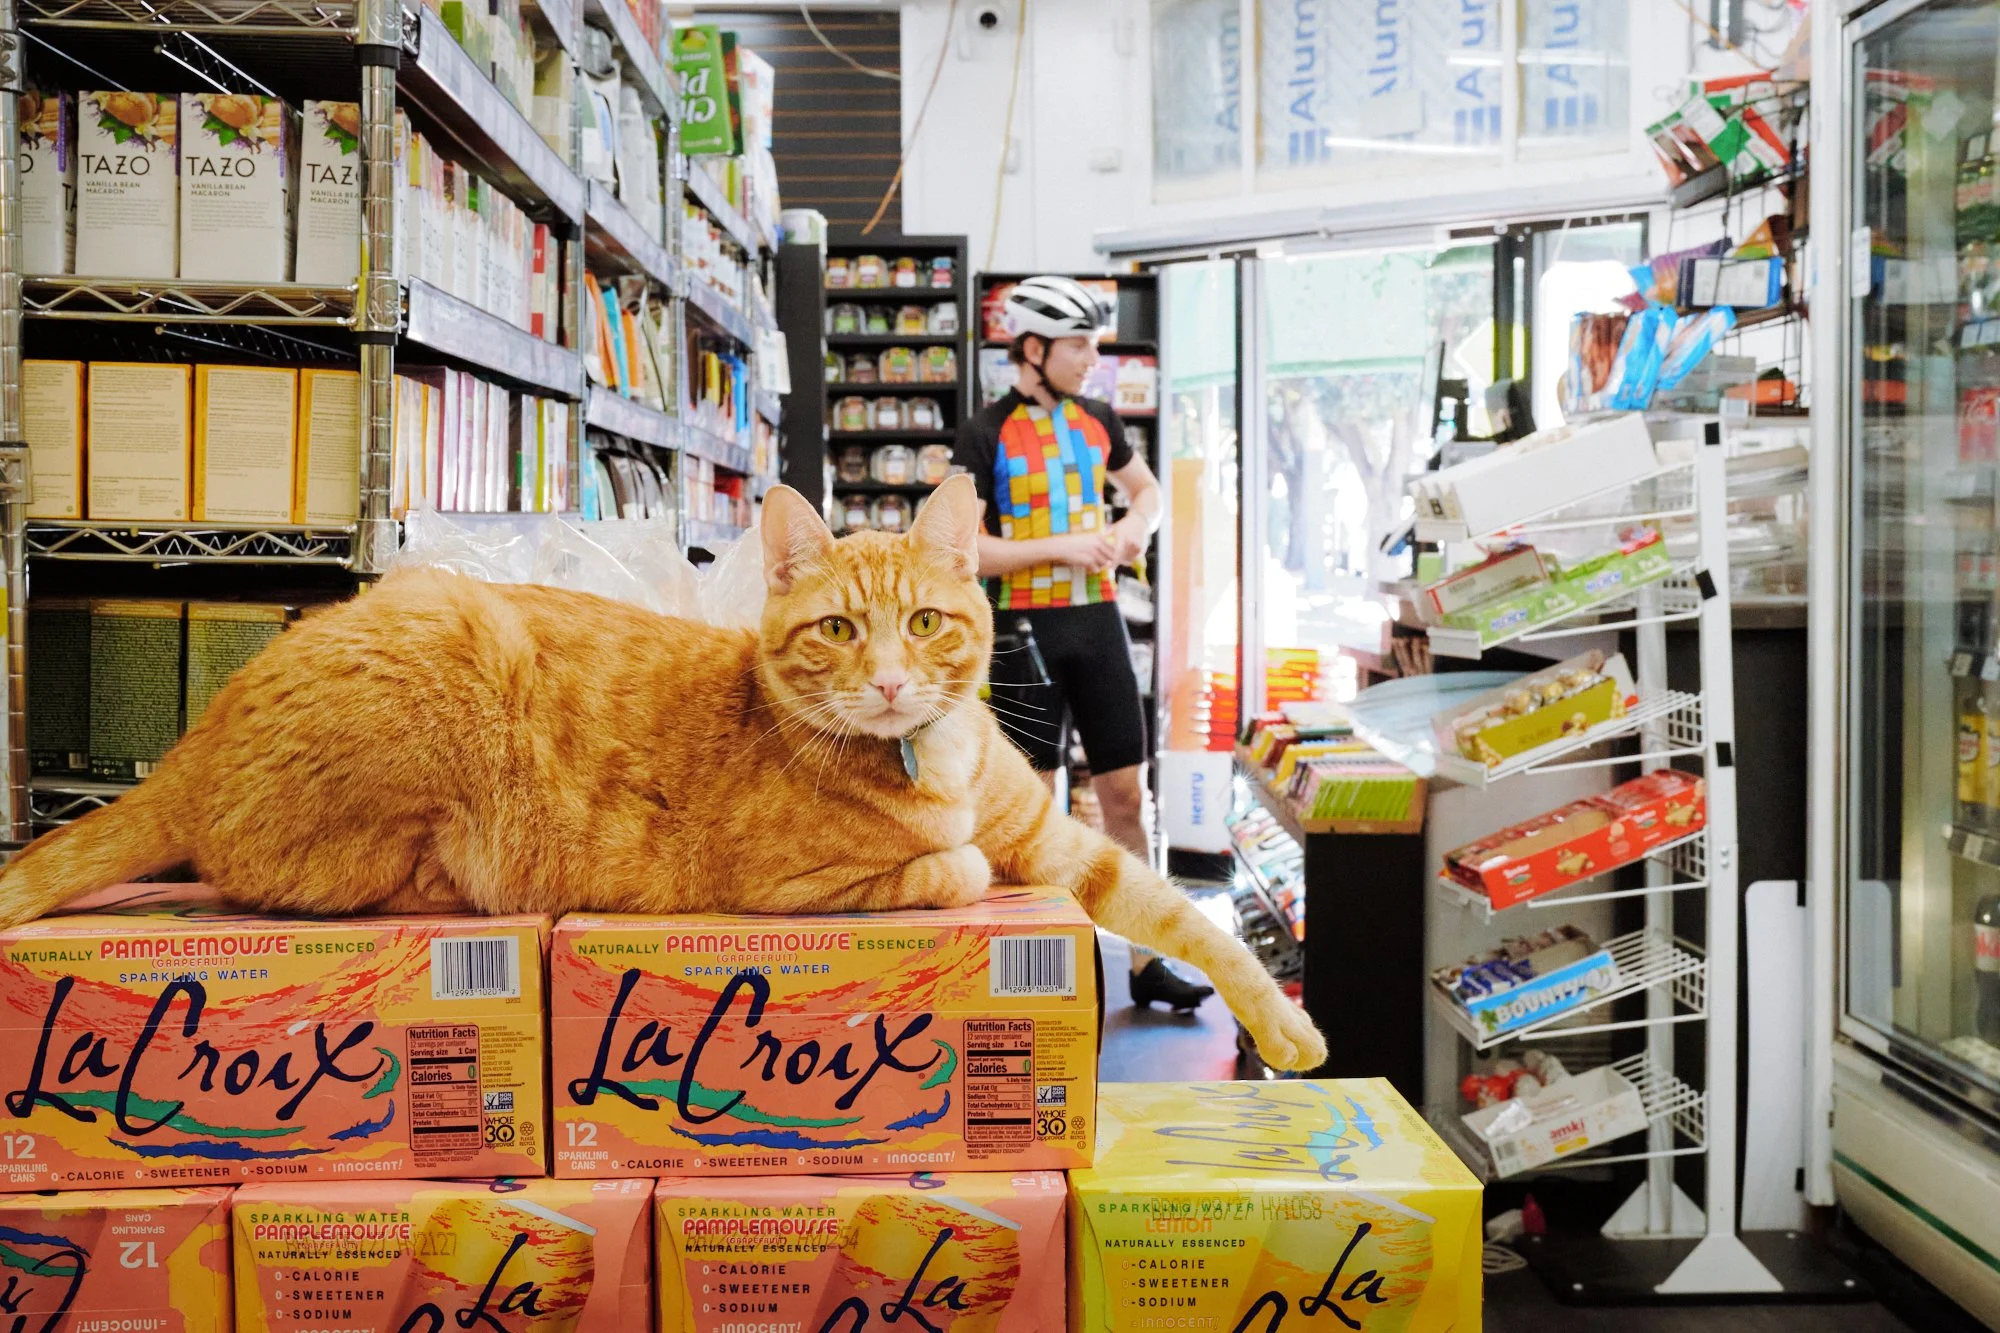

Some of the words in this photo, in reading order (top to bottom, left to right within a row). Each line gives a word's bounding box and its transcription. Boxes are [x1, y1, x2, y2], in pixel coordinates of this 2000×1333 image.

[81, 154, 151, 176] TAZO
[185, 156, 256, 178] TAZO
[306, 163, 359, 186] TAZ
[578, 943, 659, 955] NATURALLY
[857, 938, 936, 950] ESSENCED
[11, 950, 93, 964] NATURALLY
[295, 941, 375, 955] ESSENCED
[684, 965, 772, 977] SPARKLING
[780, 963, 831, 975] WATER
[119, 970, 209, 984] SPARKLING
[217, 968, 269, 981] WATER
[966, 1022, 1006, 1032] Nutrition
[1008, 1021, 1032, 1031] Facts
[409, 1029, 449, 1039] Nutrition
[452, 1027, 477, 1038] Facts
[966, 1041, 991, 1049] Serving
[1019, 1040, 1032, 1048] Can
[410, 1049, 435, 1057] Serving
[464, 1047, 477, 1055] Can
[967, 1062, 1008, 1073] Calories
[411, 1070, 453, 1082] Calories
[980, 1101, 1013, 1109] Carbohydrate
[1036, 1109, 1066, 1118] WHOLE
[484, 1116, 515, 1125] WHOLE
[1036, 1117, 1066, 1136] 30
[484, 1124, 515, 1144] 30
[565, 1122, 598, 1147] 12
[1036, 1134, 1066, 1142] approved
[4, 1135, 36, 1160] 12
[558, 1150, 609, 1161] SPARKLING
[611, 1158, 684, 1169] 0-CALORIE
[694, 1156, 788, 1168] 0-SWEETENER
[797, 1155, 864, 1166] 0-SODIUM
[887, 1150, 956, 1164] INNOCENT!
[51, 1170, 125, 1182] 0-CALORIE
[135, 1167, 231, 1180] 0-SWEETENER
[241, 1164, 308, 1176] 0-SODIUM
[332, 1159, 404, 1173] INNOCENT!
[570, 1160, 597, 1170] CANS
[10, 1173, 36, 1183] CANS
[678, 1207, 772, 1217] SPARKLING
[782, 1206, 836, 1217] WATER
[1098, 1203, 1192, 1213] SPARKLING
[1201, 1203, 1255, 1213] WATER
[125, 1214, 152, 1223] CANS
[250, 1213, 344, 1223] SPARKLING
[355, 1212, 410, 1223] WATER
[112, 1224, 166, 1235] SPARKLING
[685, 1244, 755, 1253] NATURALLY
[763, 1244, 827, 1253] ESSENCED
[1105, 1239, 1175, 1248] NATURALLY
[1182, 1239, 1246, 1248] ESSENCED
[119, 1241, 160, 1269] 12
[258, 1250, 328, 1259] NATURALLY
[336, 1250, 402, 1259] ESSENCED
[702, 1264, 786, 1275] 0-CALORIE
[1121, 1259, 1206, 1270] 0-CALORIE
[274, 1271, 360, 1281] 0-CALORIE
[702, 1283, 811, 1294] 0-SWEETENER
[1122, 1278, 1230, 1289] 0-SWEETENER
[275, 1290, 385, 1300] 0-SWEETENER
[1122, 1297, 1197, 1307] 0-SODIUM
[702, 1303, 778, 1313] 0-SODIUM
[275, 1309, 352, 1319] 0-SODIUM
